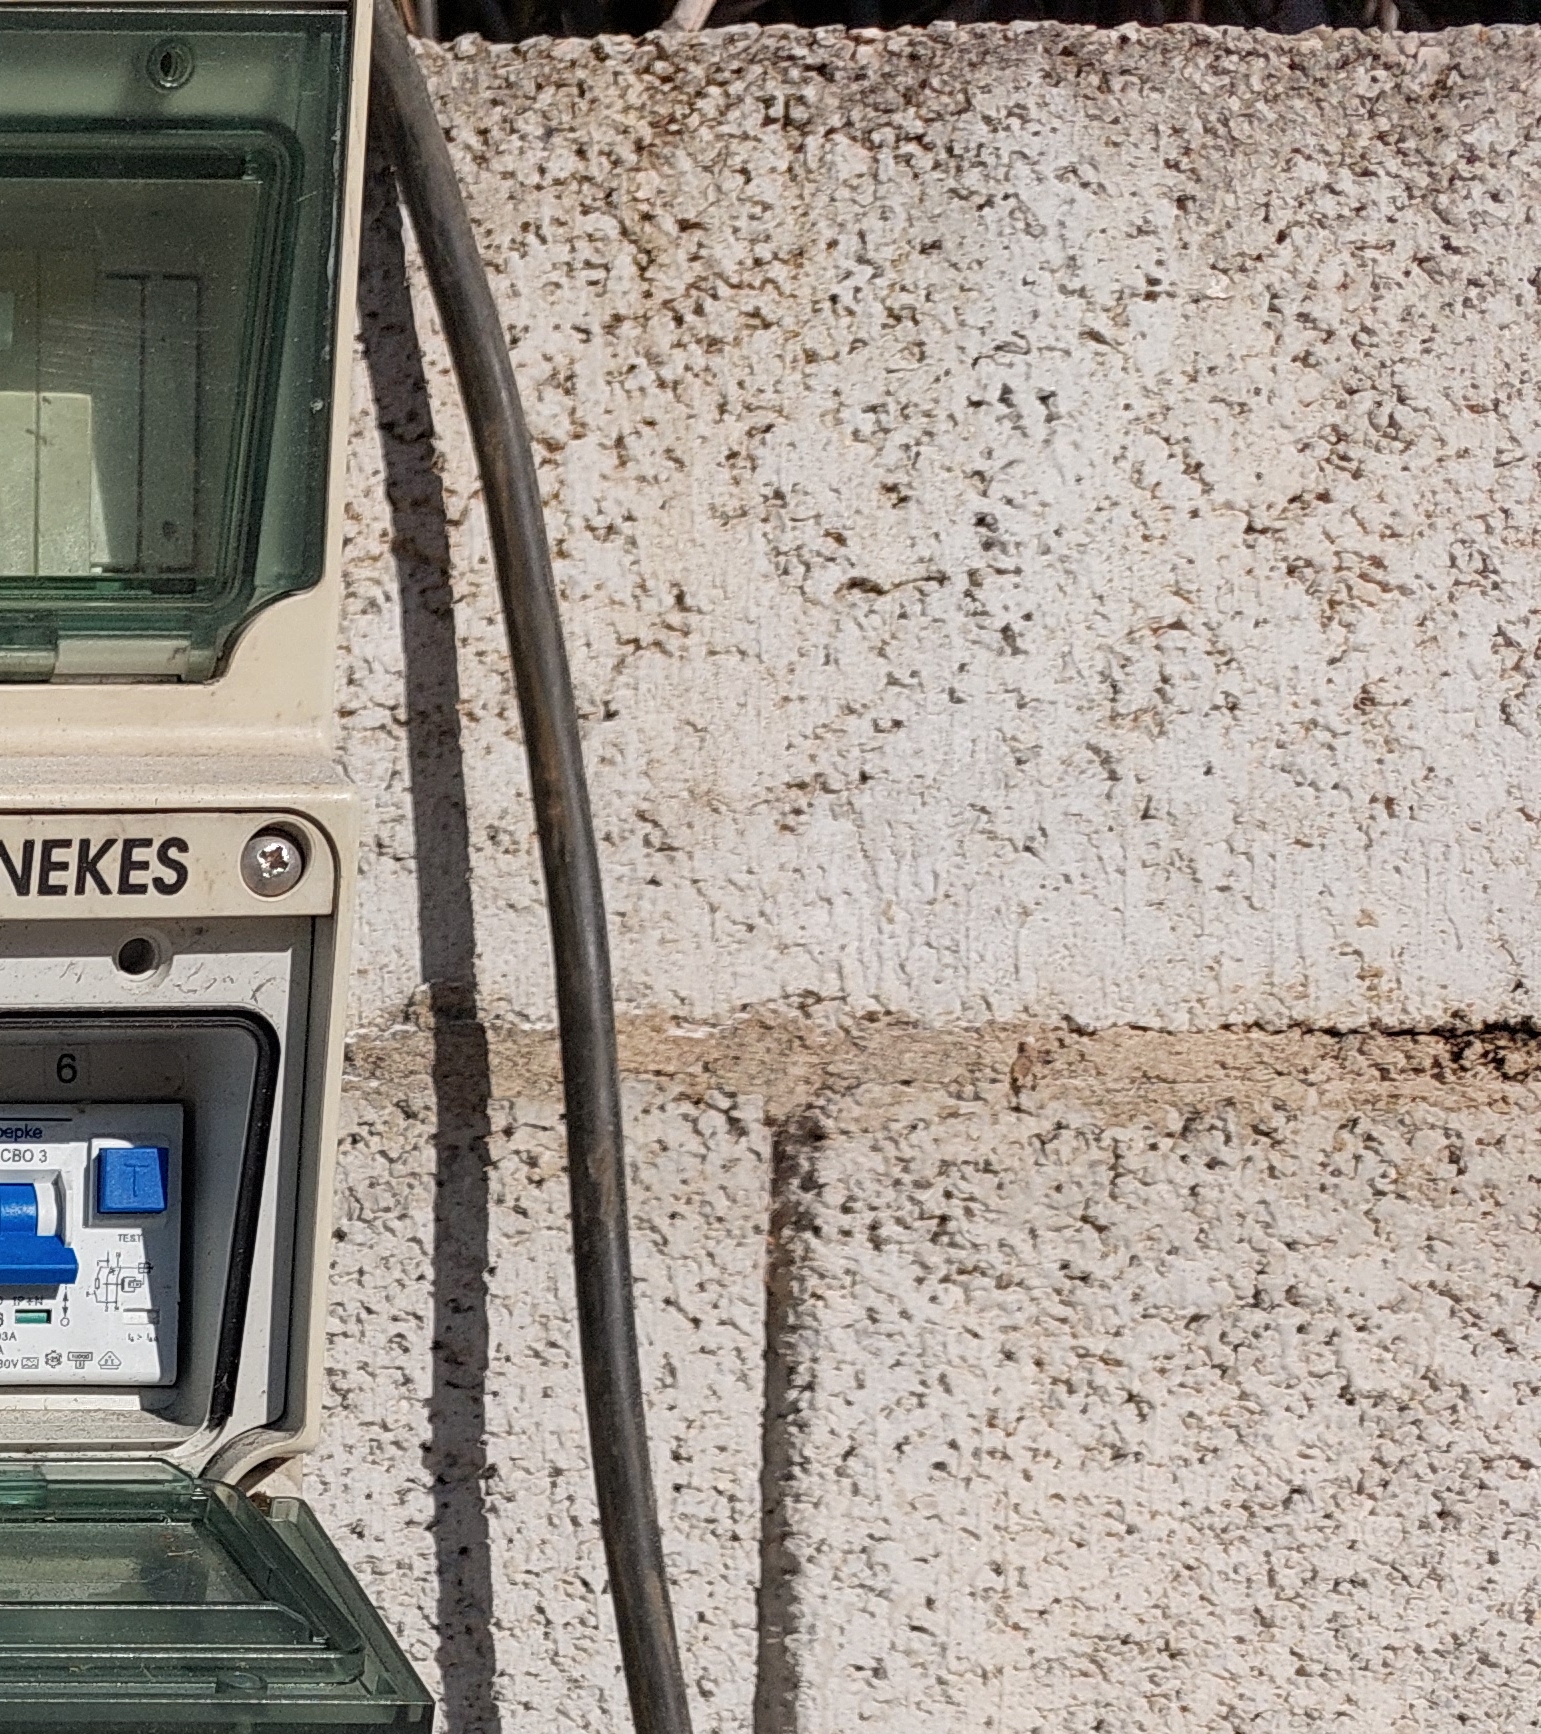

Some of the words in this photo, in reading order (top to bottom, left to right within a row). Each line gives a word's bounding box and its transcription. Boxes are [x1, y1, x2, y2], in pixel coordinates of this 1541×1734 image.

[57, 1054, 77, 1084] 6
[39, 1149, 47, 1162] 3
[124, 1163, 148, 1197] T
[118, 1234, 142, 1242] TEST
